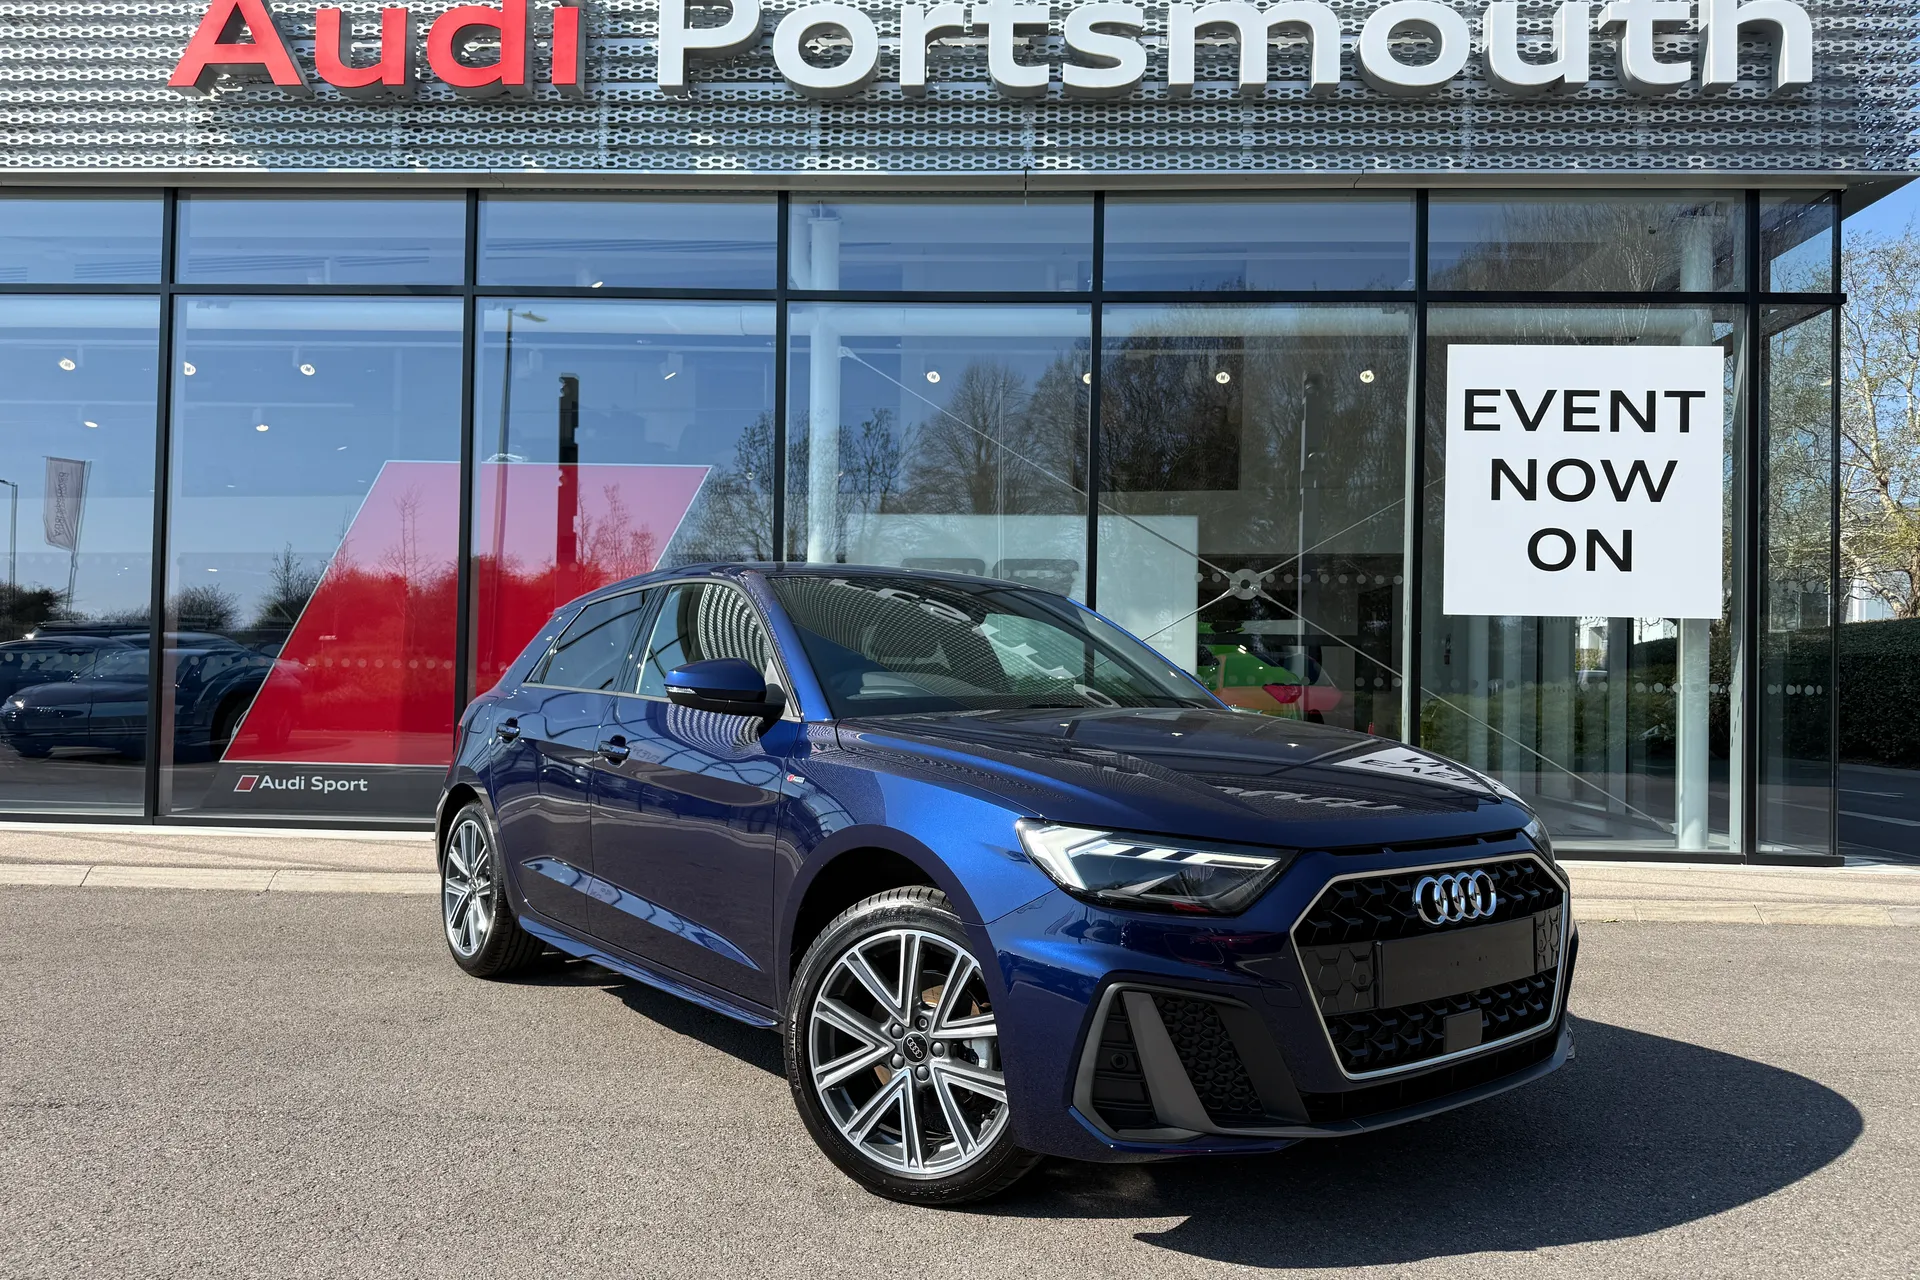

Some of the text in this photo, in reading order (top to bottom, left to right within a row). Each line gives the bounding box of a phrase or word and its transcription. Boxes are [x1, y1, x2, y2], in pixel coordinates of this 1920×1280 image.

[167, 0, 1814, 89] Audi Portsmouth
[1464, 388, 1706, 434] EVENT
[1490, 458, 1679, 503] NOW
[1527, 527, 1633, 573] ON
[259, 775, 368, 794] Audi Sport
